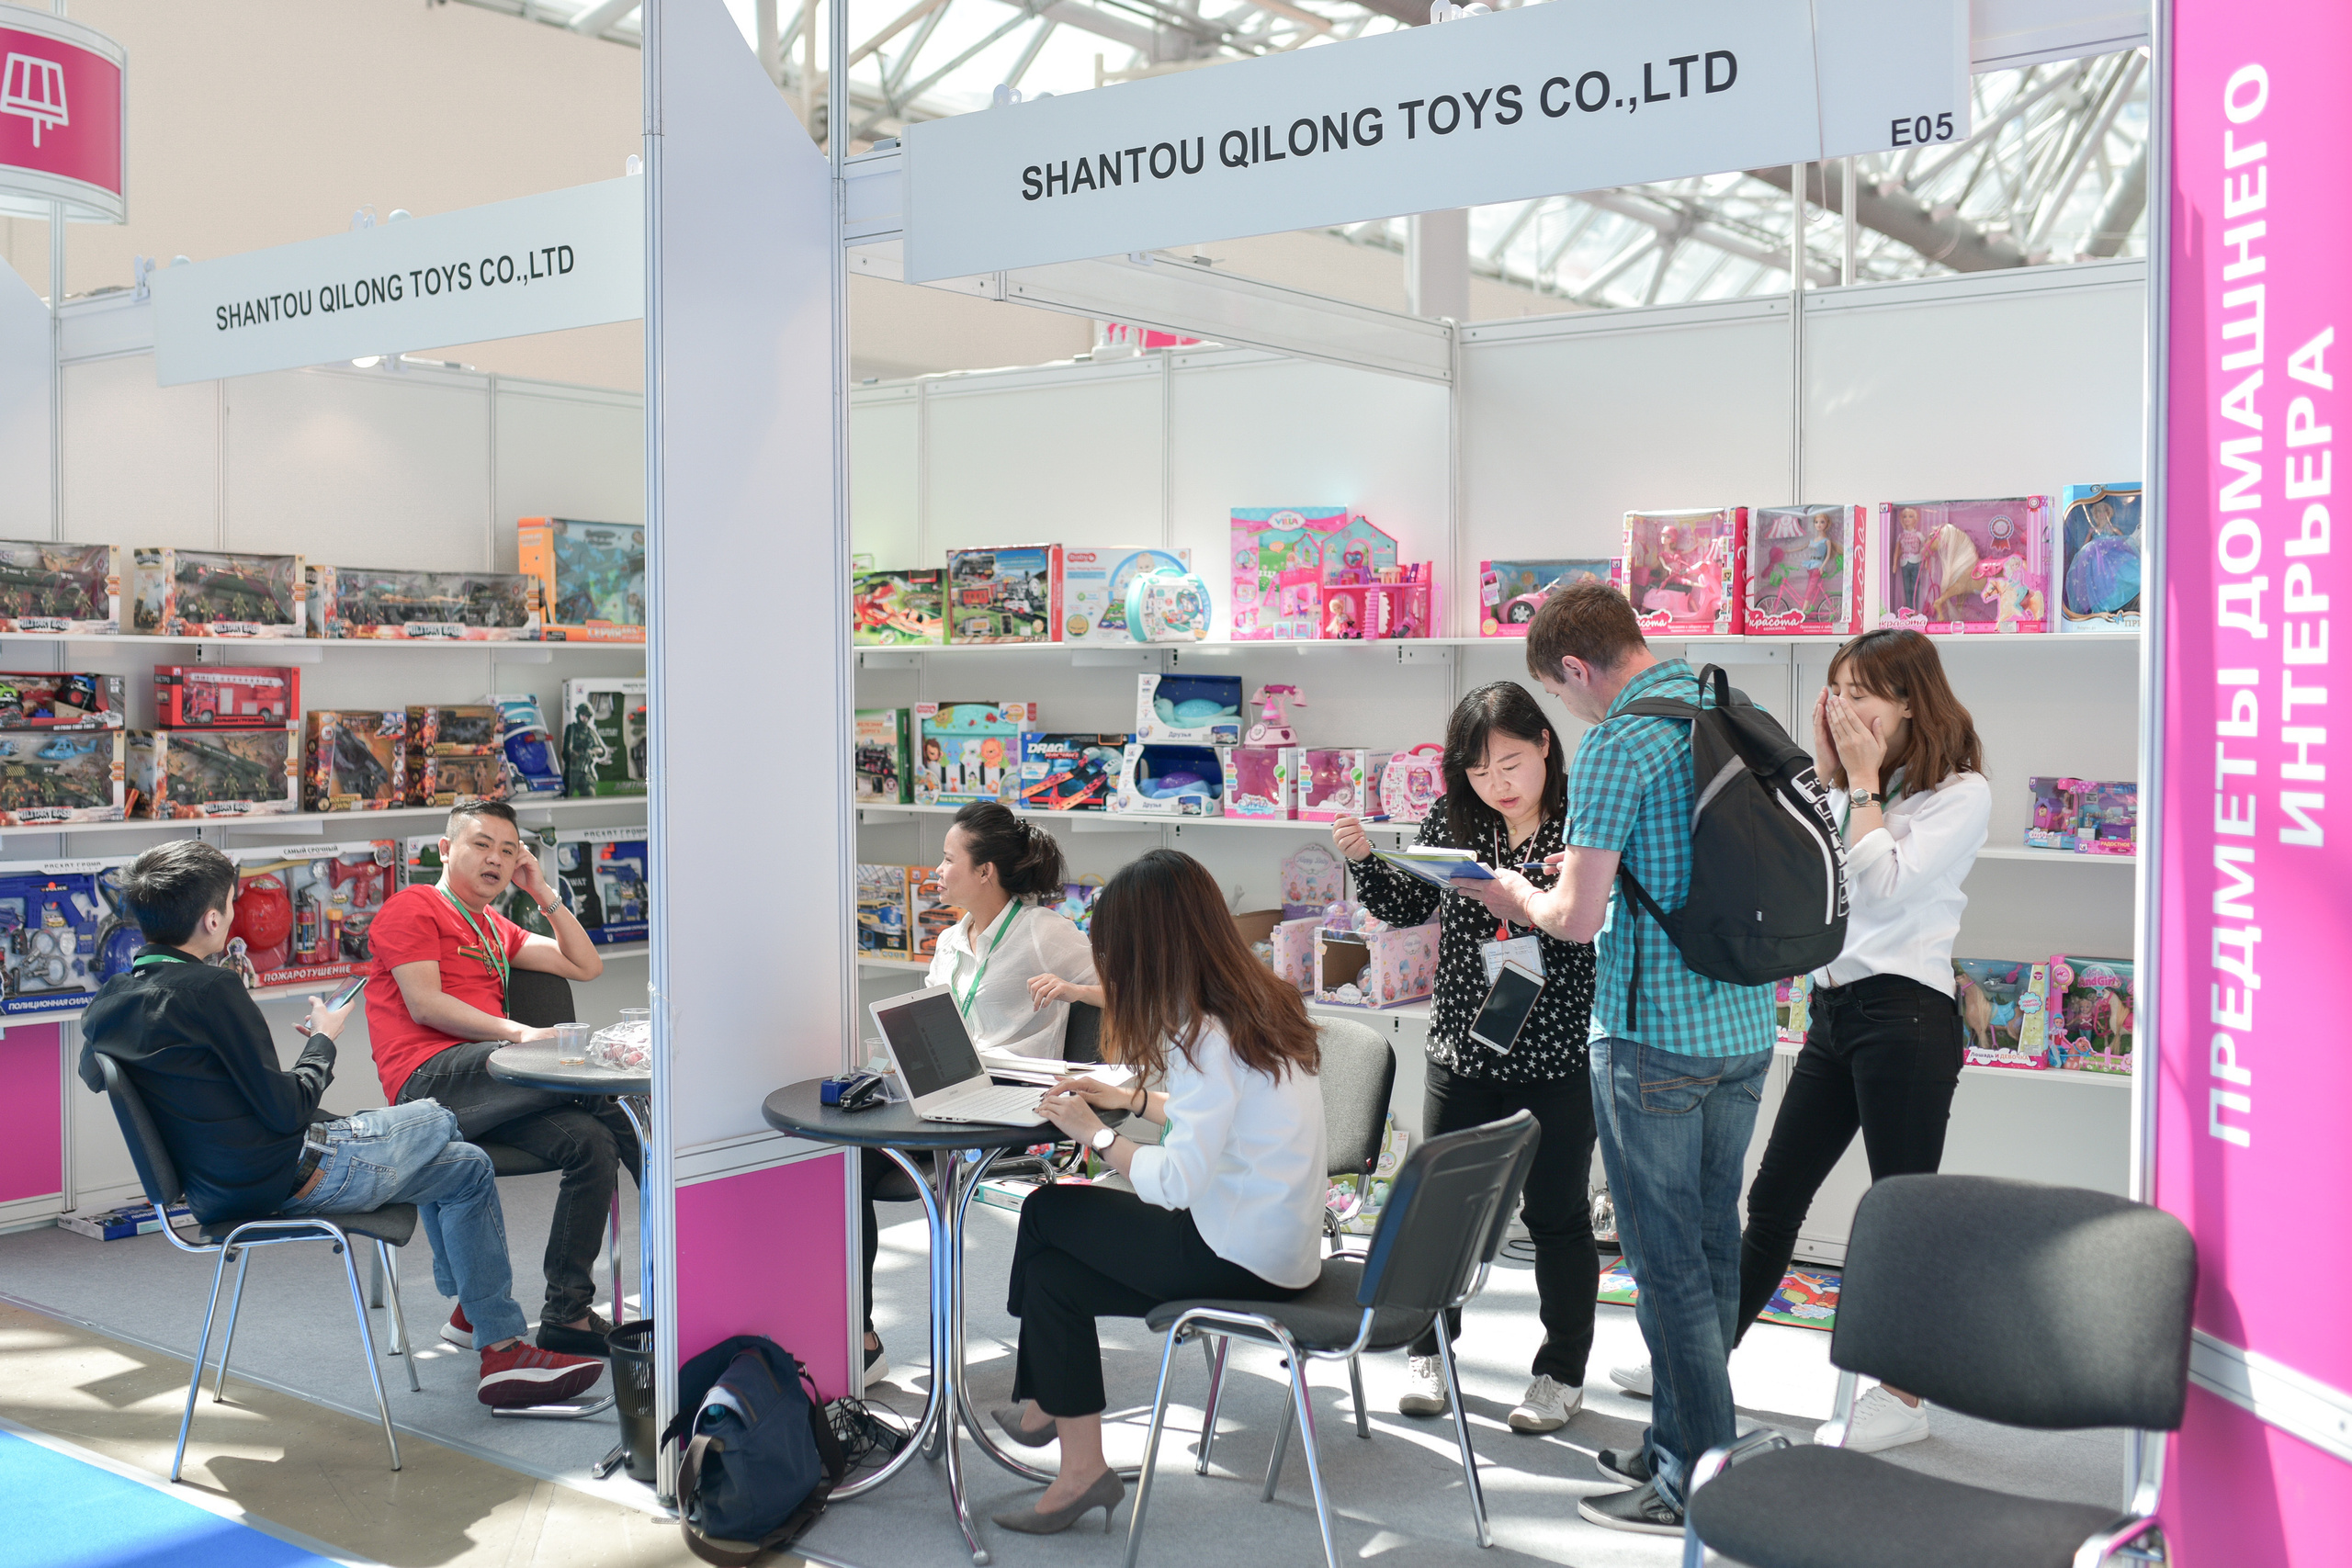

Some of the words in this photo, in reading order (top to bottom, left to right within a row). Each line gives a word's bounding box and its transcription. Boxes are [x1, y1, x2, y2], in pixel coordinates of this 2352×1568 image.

[1022, 137, 1204, 201] SHANTOU
[1219, 107, 1384, 168] QILONG
[1397, 84, 1523, 140] TOYS
[1540, 50, 1737, 118] CO.,LTD
[1891, 111, 1953, 147] E05
[216, 289, 312, 331] SHANTOU
[319, 274, 403, 313] QILONG
[409, 262, 472, 298] TOYS
[480, 244, 574, 287] CO.,LTD
[2218, 63, 2269, 639] ДОМАШНЕГО
[2279, 326, 2335, 847] ИНТЕРЬЕРА
[1748, 615, 1800, 631] красота
[1880, 618, 1928, 629] красота
[1026, 742, 1063, 754] DRAG
[18, 808, 52, 819] MILITARY
[52, 808, 74, 819] BASE
[283, 846, 307, 855] САМЫЙ
[307, 845, 338, 853] СРОЧНЫЙ
[2210, 668, 2262, 1148] ПРЕДМЕТЫ
[264, 964, 352, 983] ПОЖАРОТУШЕНИЕ
[8, 998, 68, 1010] ПОЛИЦИОННАЯ
[68, 997, 88, 1006] СИЛА
[1970, 1051, 1995, 1059] Лошадь
